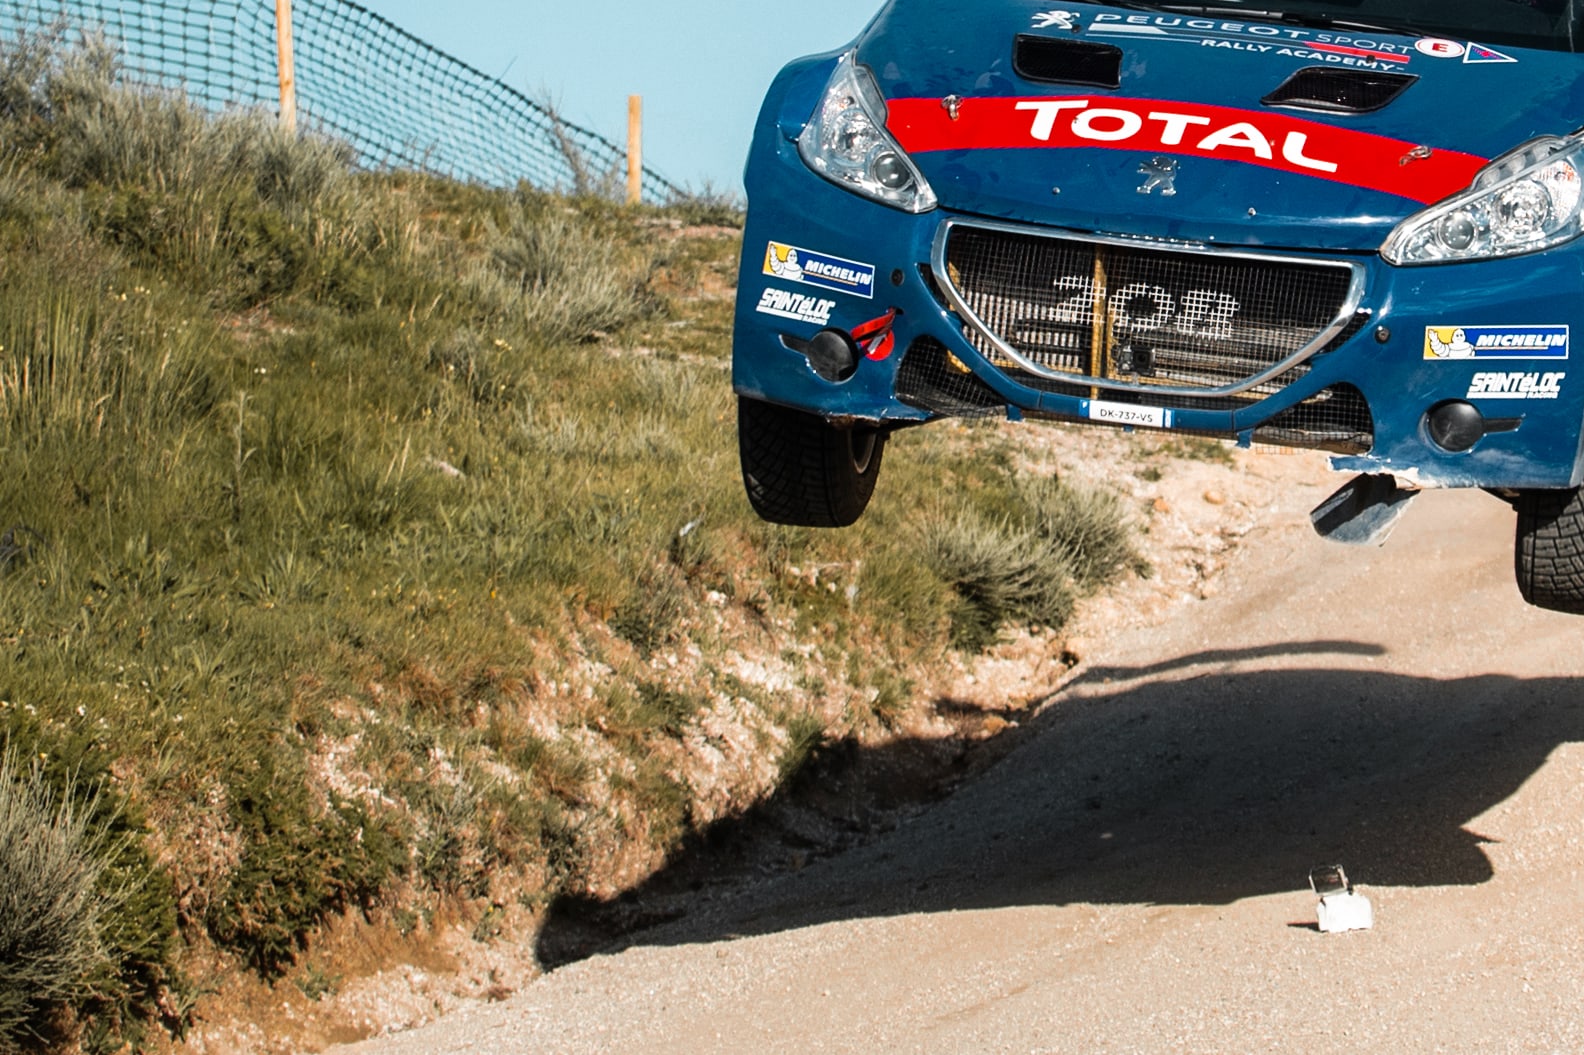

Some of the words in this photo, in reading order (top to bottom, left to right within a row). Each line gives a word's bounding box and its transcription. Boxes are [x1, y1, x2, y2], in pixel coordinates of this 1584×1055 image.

[1094, 13, 1310, 39] PEUGEOT
[1315, 33, 1416, 55] SPORT
[1431, 42, 1450, 54] E
[1200, 38, 1273, 53] RALLY
[1276, 47, 1396, 71] ACADEMY
[1014, 99, 1338, 173] TOTAL
[804, 259, 873, 286] MICHELIN
[1049, 274, 1241, 341] 208
[1475, 333, 1567, 347] MICHELIN
[1099, 408, 1154, 423] DK-737-VS
